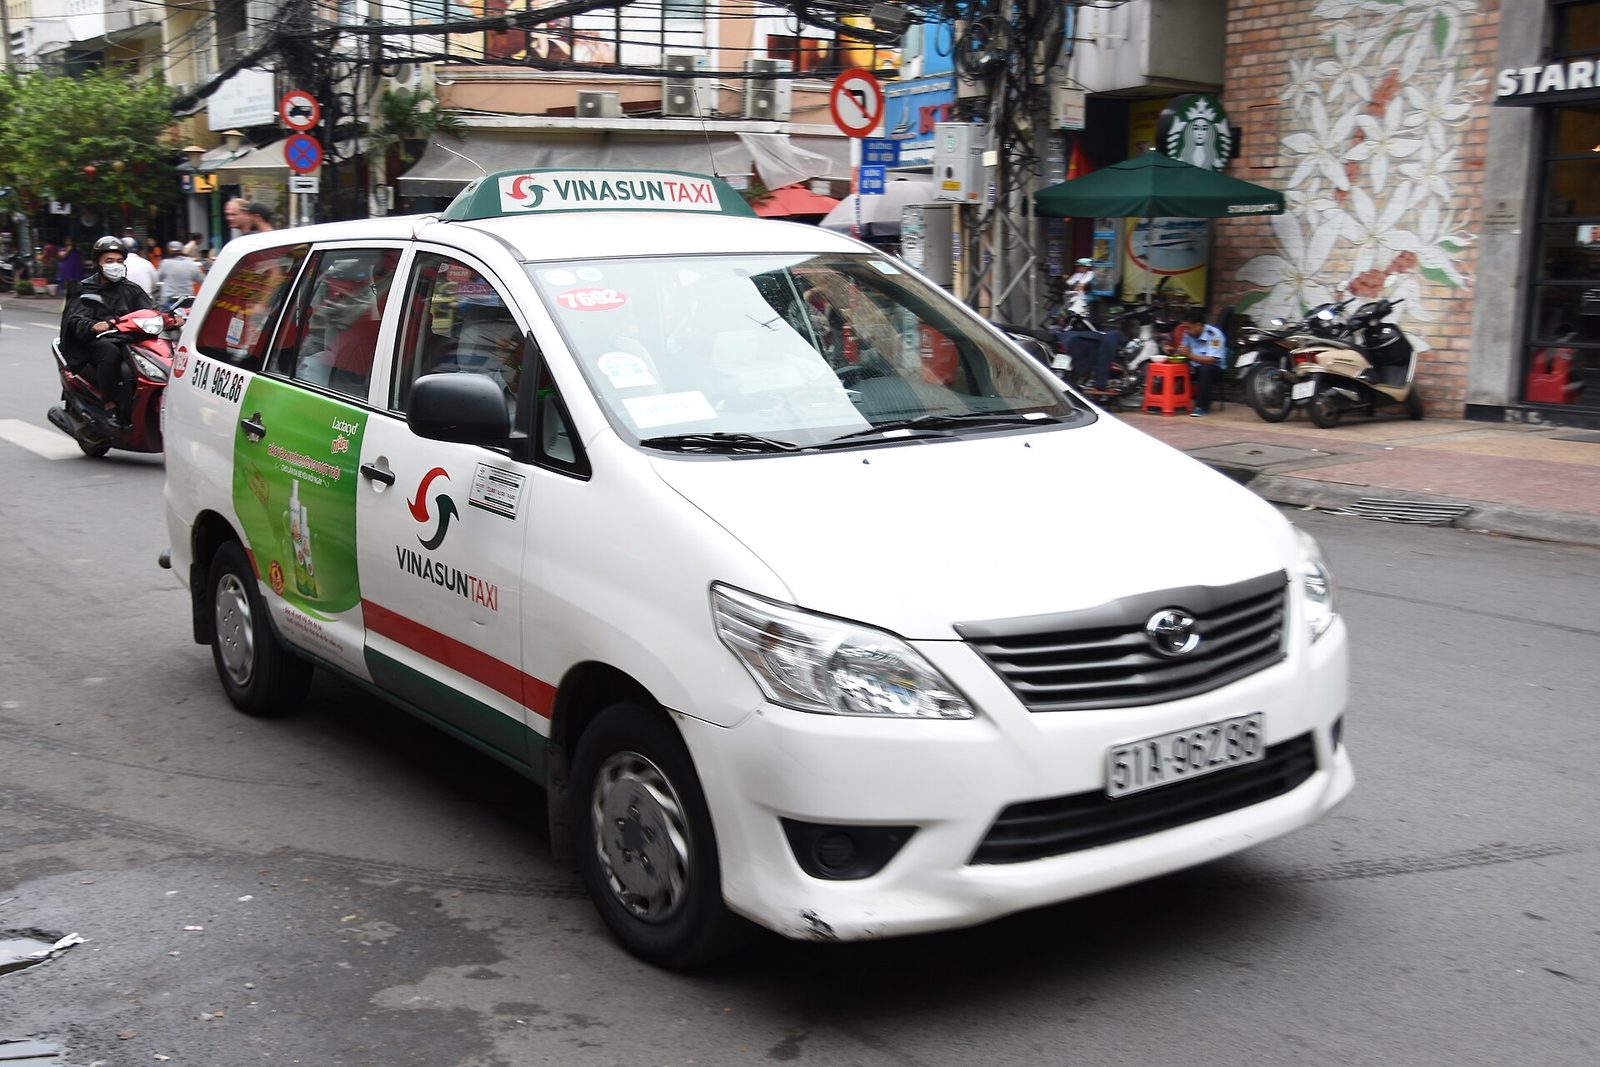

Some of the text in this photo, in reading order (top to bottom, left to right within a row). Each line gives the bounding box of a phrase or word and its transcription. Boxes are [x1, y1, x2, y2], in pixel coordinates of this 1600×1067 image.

[1497, 59, 1600, 97] STAR
[192, 360, 244, 403] 51A 962.86
